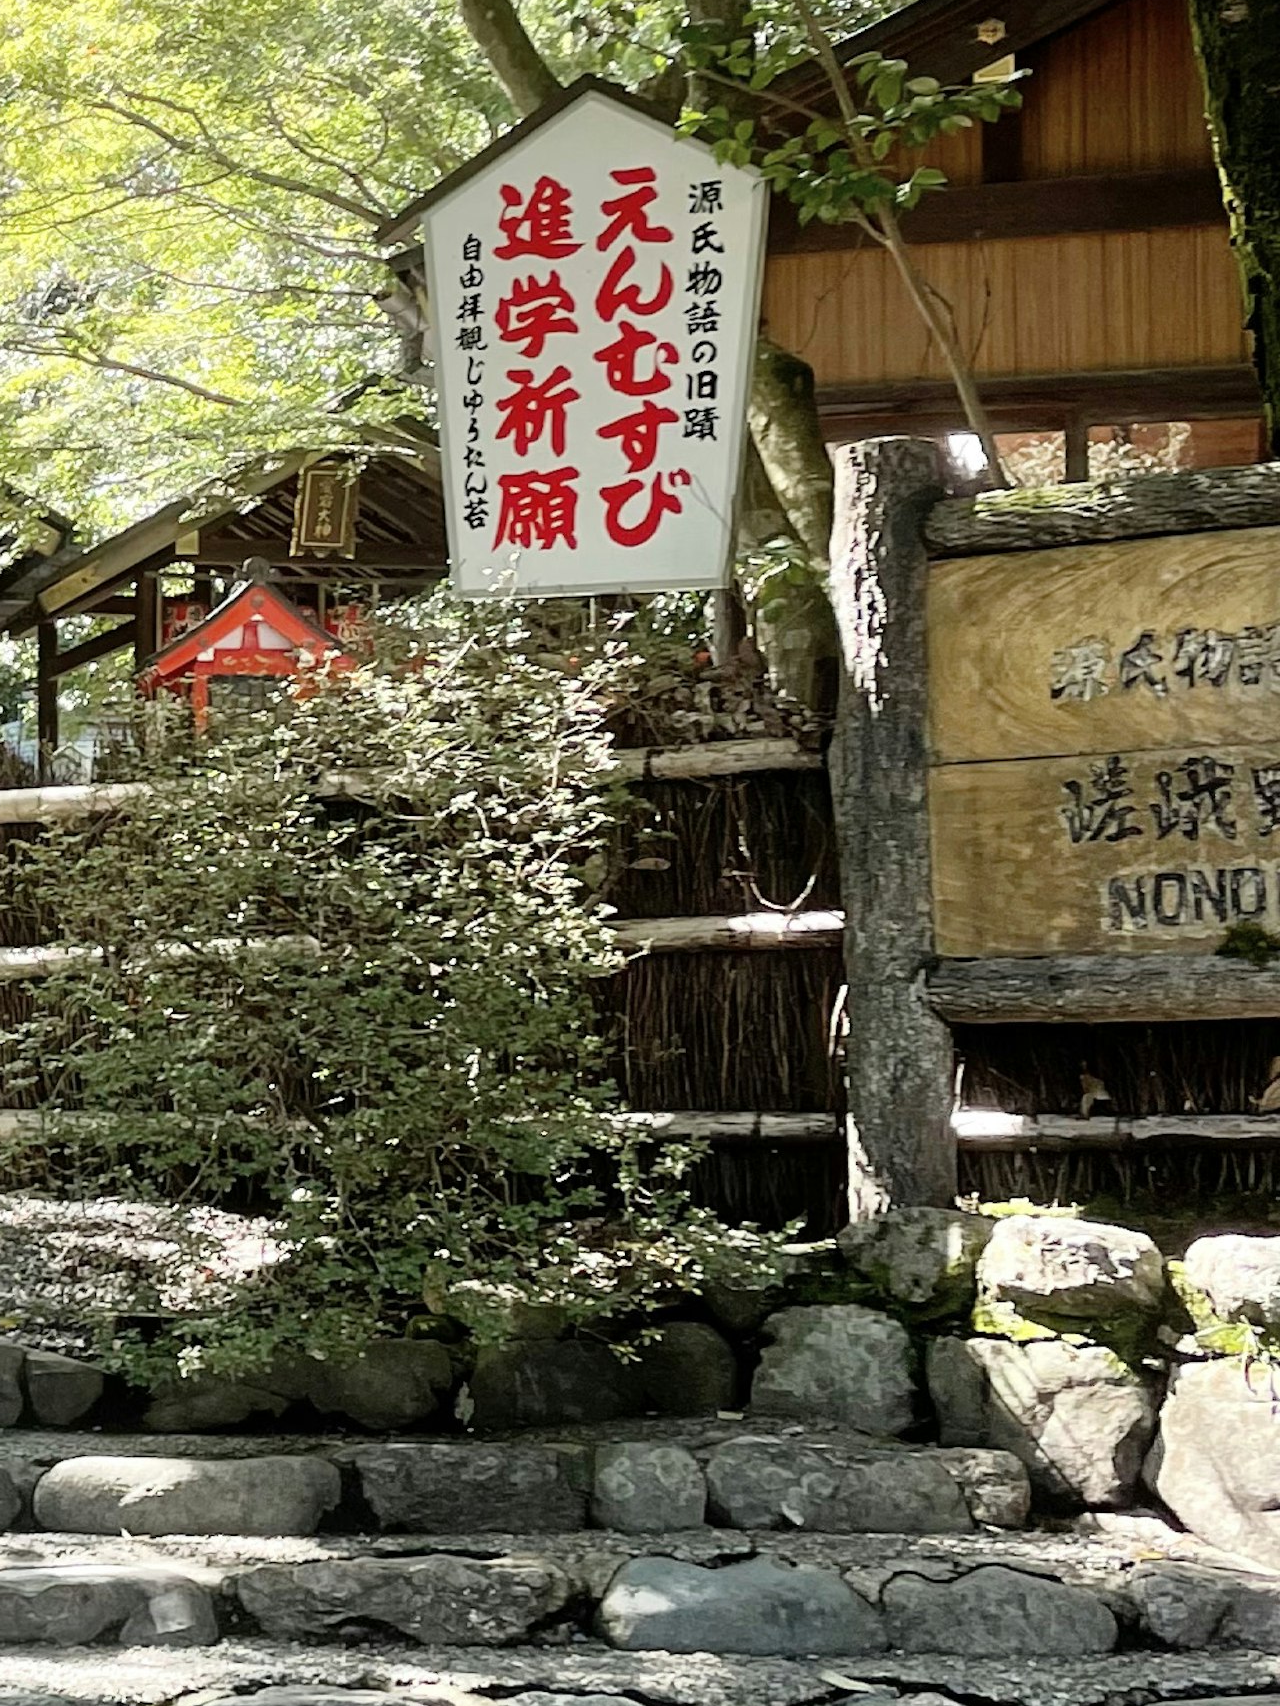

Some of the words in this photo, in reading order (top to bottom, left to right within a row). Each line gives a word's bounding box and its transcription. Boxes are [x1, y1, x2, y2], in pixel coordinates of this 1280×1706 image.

[491, 175, 587, 553] 進学祈願
[593, 166, 692, 548] えんむすび
[682, 180, 725, 442] 源氏物語の旧蹟
[1107, 867, 1280, 931] NONO
